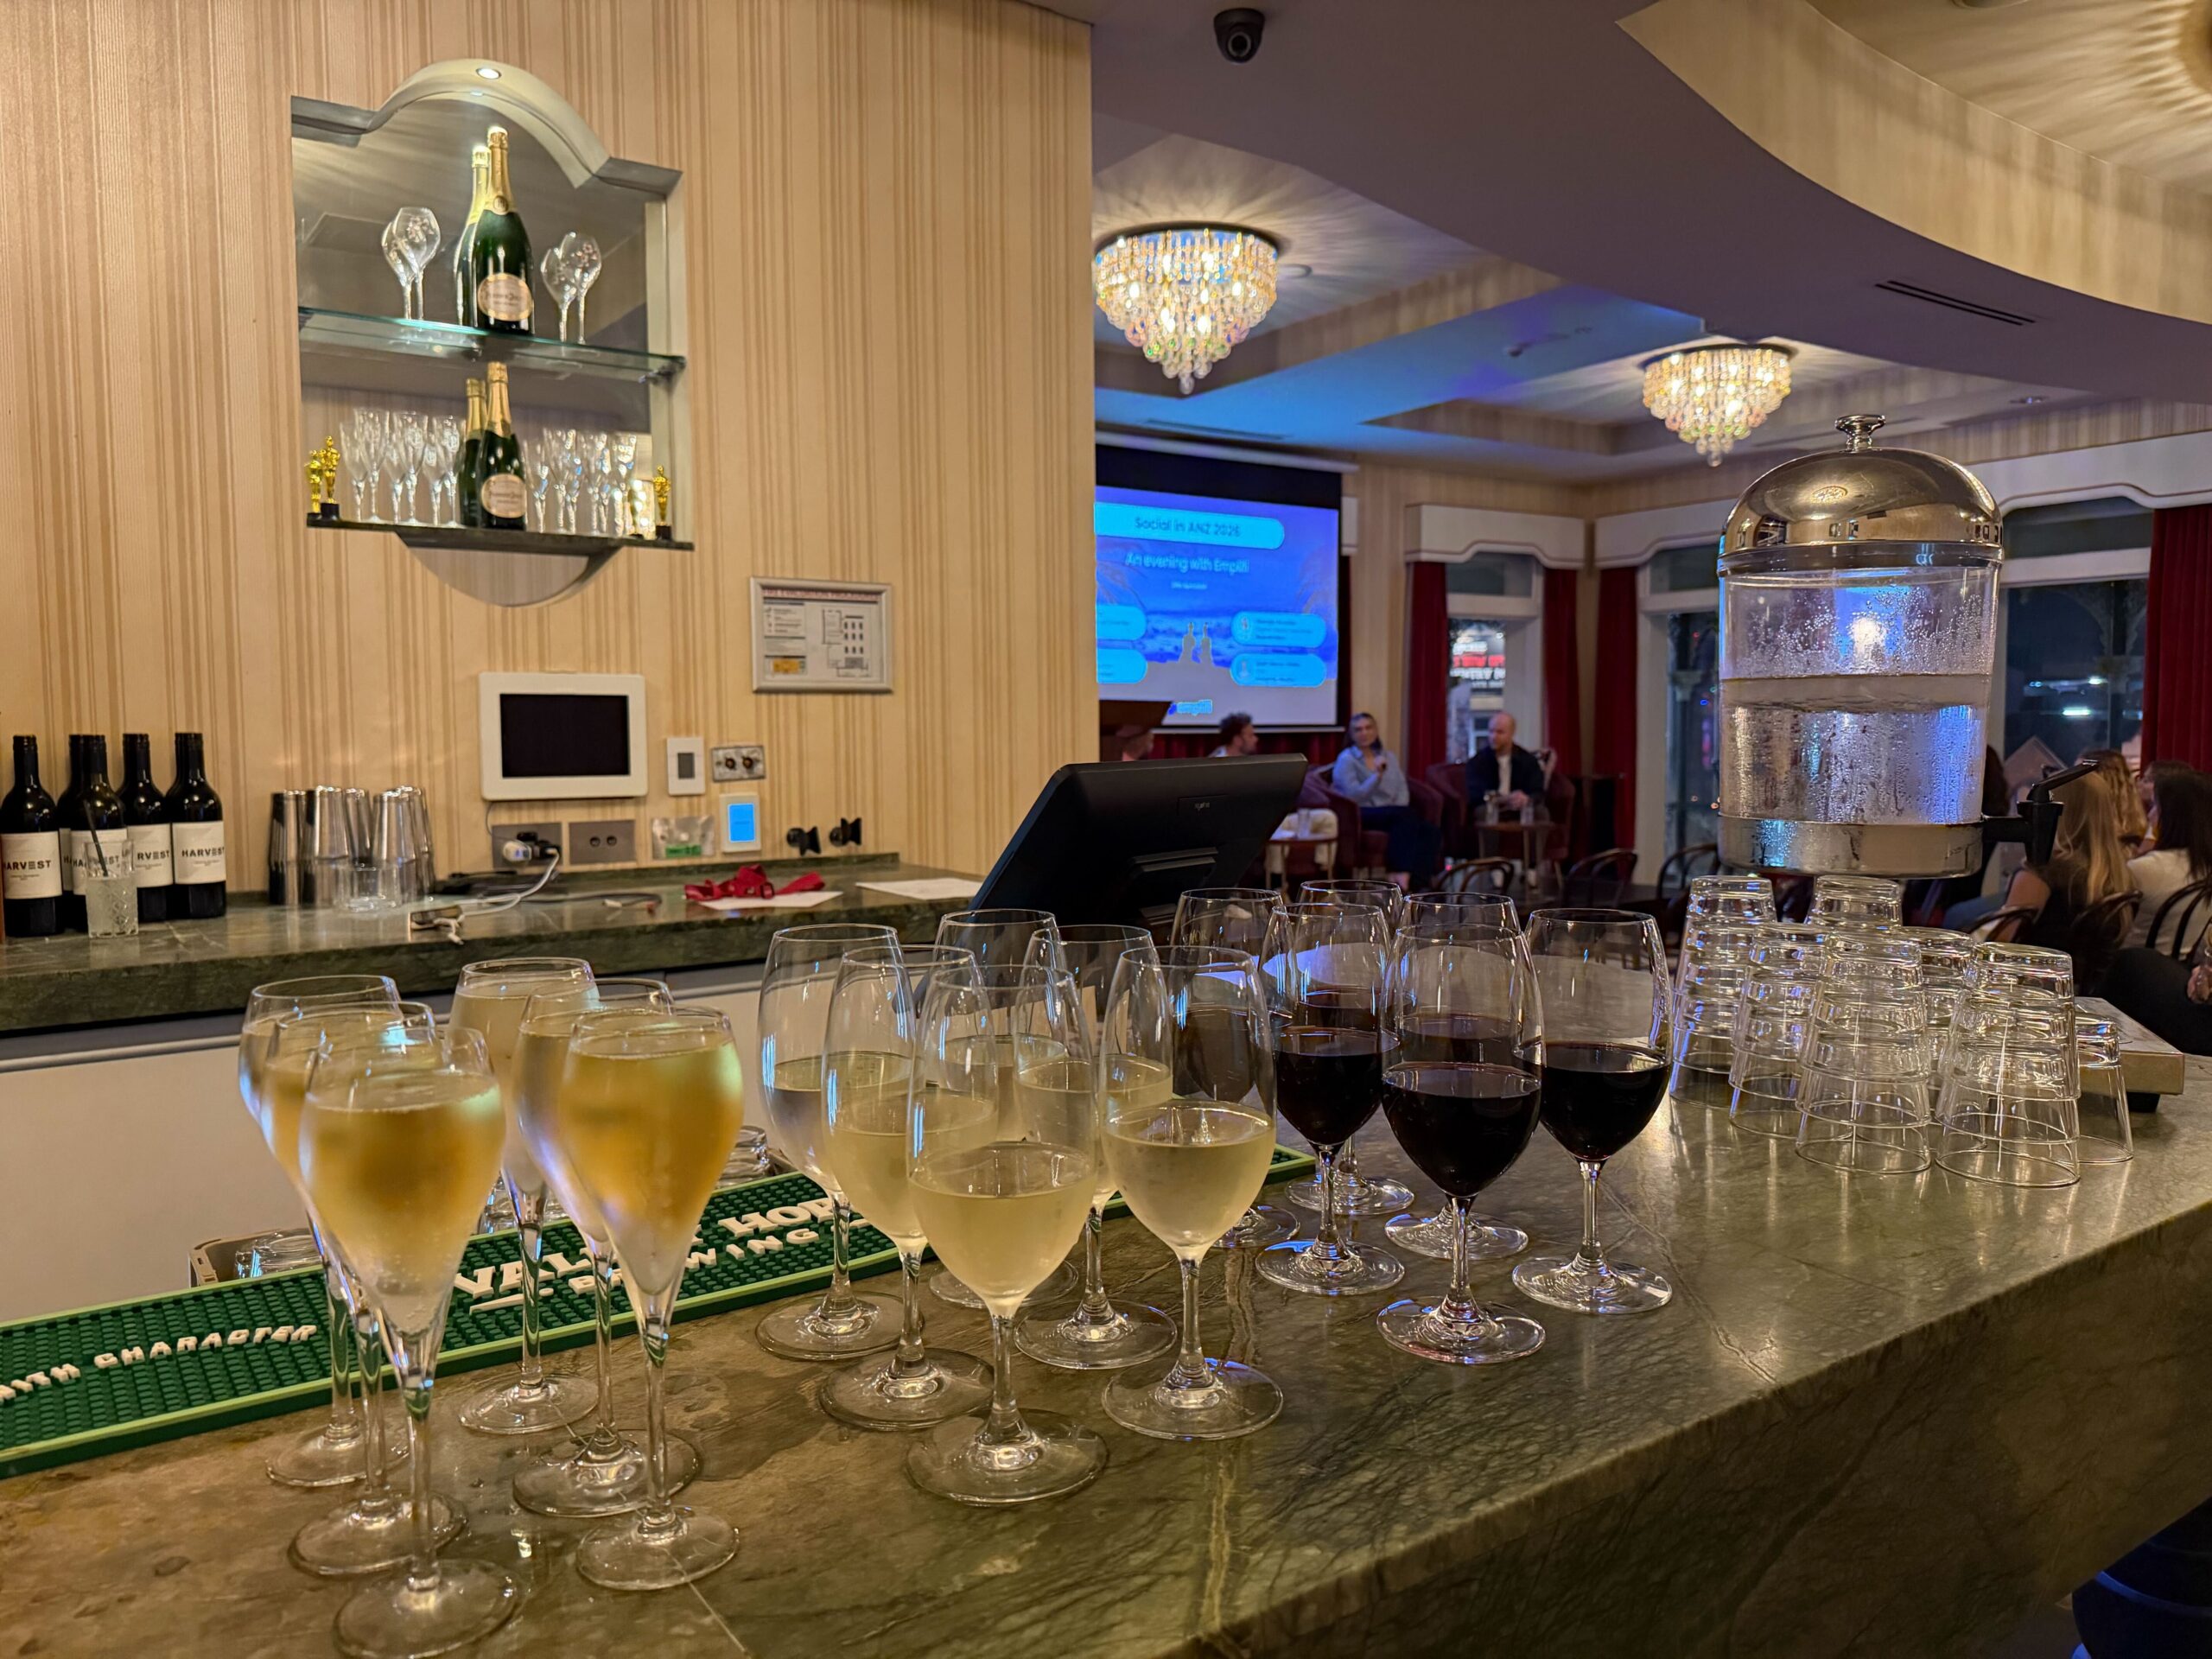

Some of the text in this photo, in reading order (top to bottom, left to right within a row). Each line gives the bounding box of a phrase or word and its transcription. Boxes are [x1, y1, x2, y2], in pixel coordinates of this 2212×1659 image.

[1134, 517, 1172, 531] Social
[1173, 519, 1186, 532] in
[1125, 551, 1143, 567] An
[1143, 553, 1189, 574] evening
[1189, 556, 1213, 571] with
[137, 849, 170, 861] RVEST
[93, 1324, 317, 1370] CHARACTER
